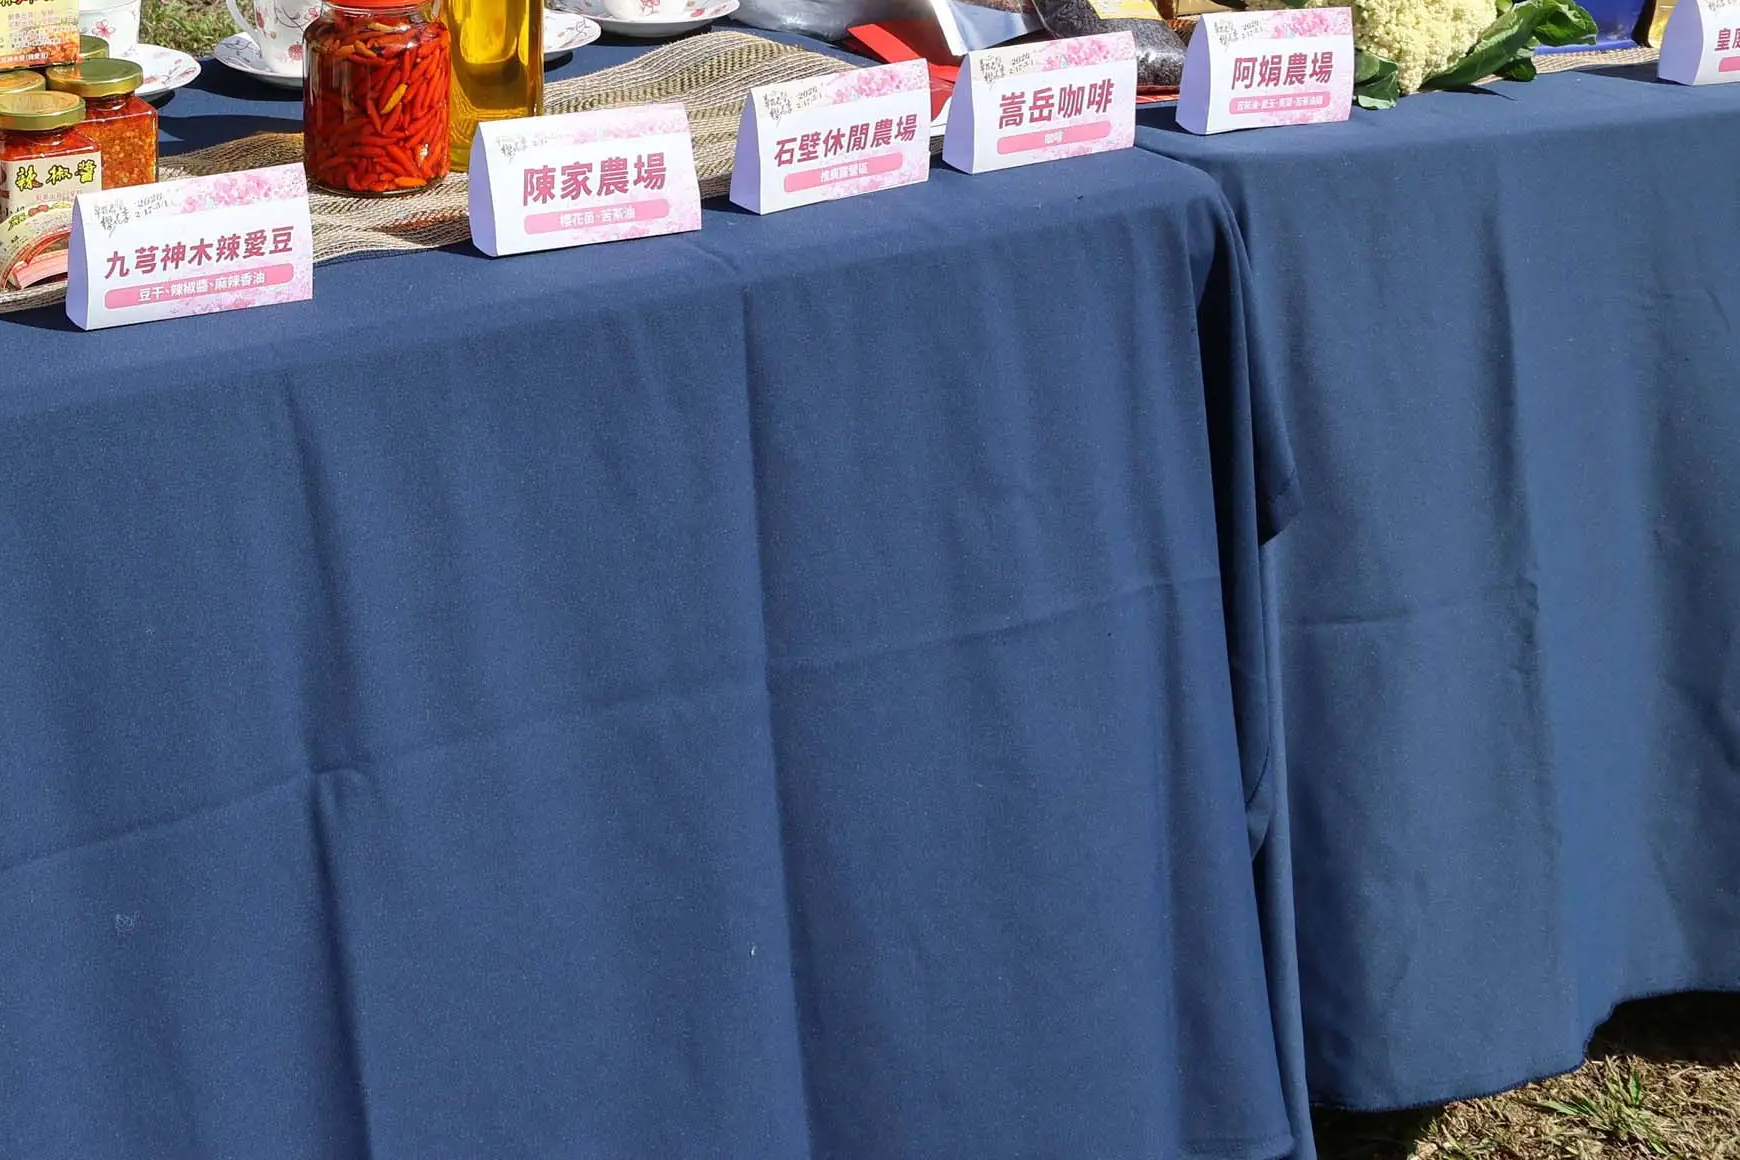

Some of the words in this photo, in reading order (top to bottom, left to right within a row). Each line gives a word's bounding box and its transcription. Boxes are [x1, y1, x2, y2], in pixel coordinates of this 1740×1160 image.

[1230, 51, 1334, 91] 阿娟農場
[998, 78, 1116, 130] 嵩岳咖啡
[773, 113, 918, 167] 石壁休閒農場
[14, 159, 97, 192] 辣椒醬
[522, 151, 667, 206] 陳家農場
[103, 225, 295, 280] 九芎神木辣愛豆
